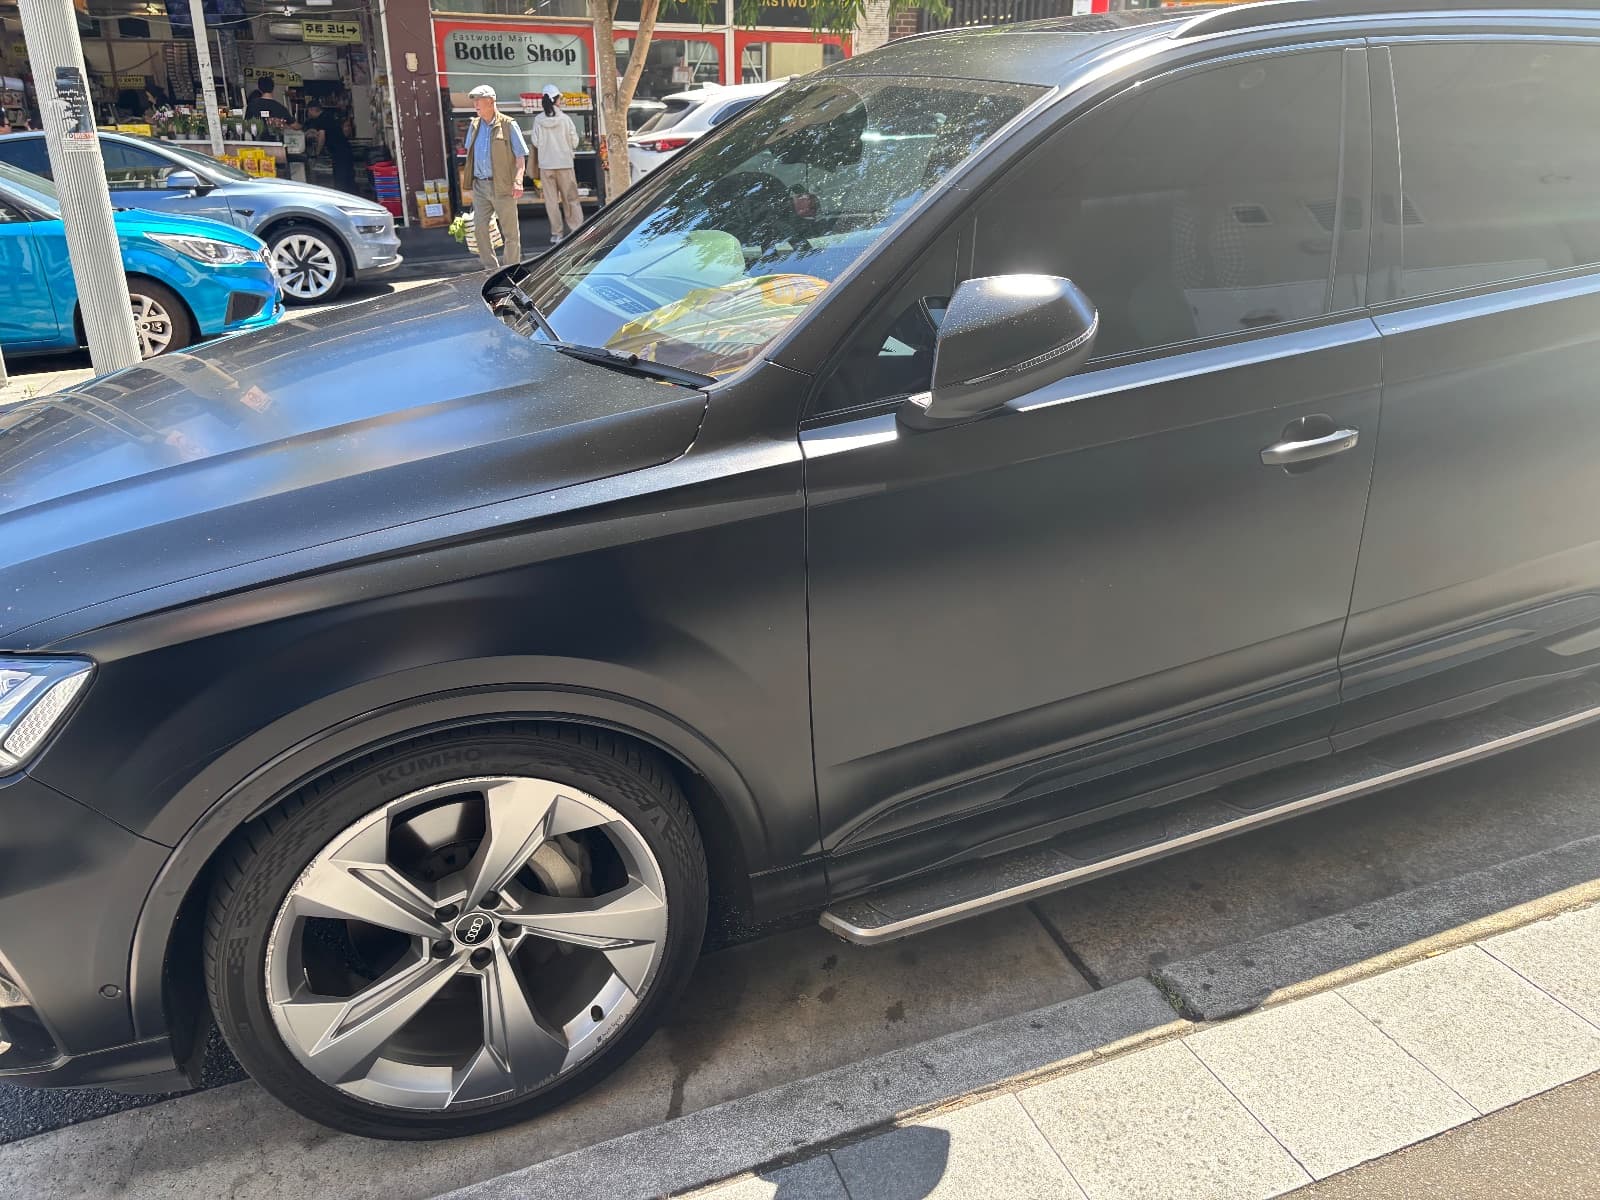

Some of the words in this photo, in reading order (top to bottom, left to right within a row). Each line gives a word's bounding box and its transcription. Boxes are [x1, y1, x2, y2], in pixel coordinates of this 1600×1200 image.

[453, 32, 503, 42] Eastwood
[508, 34, 534, 43] Mart
[454, 42, 516, 60] Bottle
[527, 44, 576, 65] Shop
[375, 749, 482, 786] KUMHO
